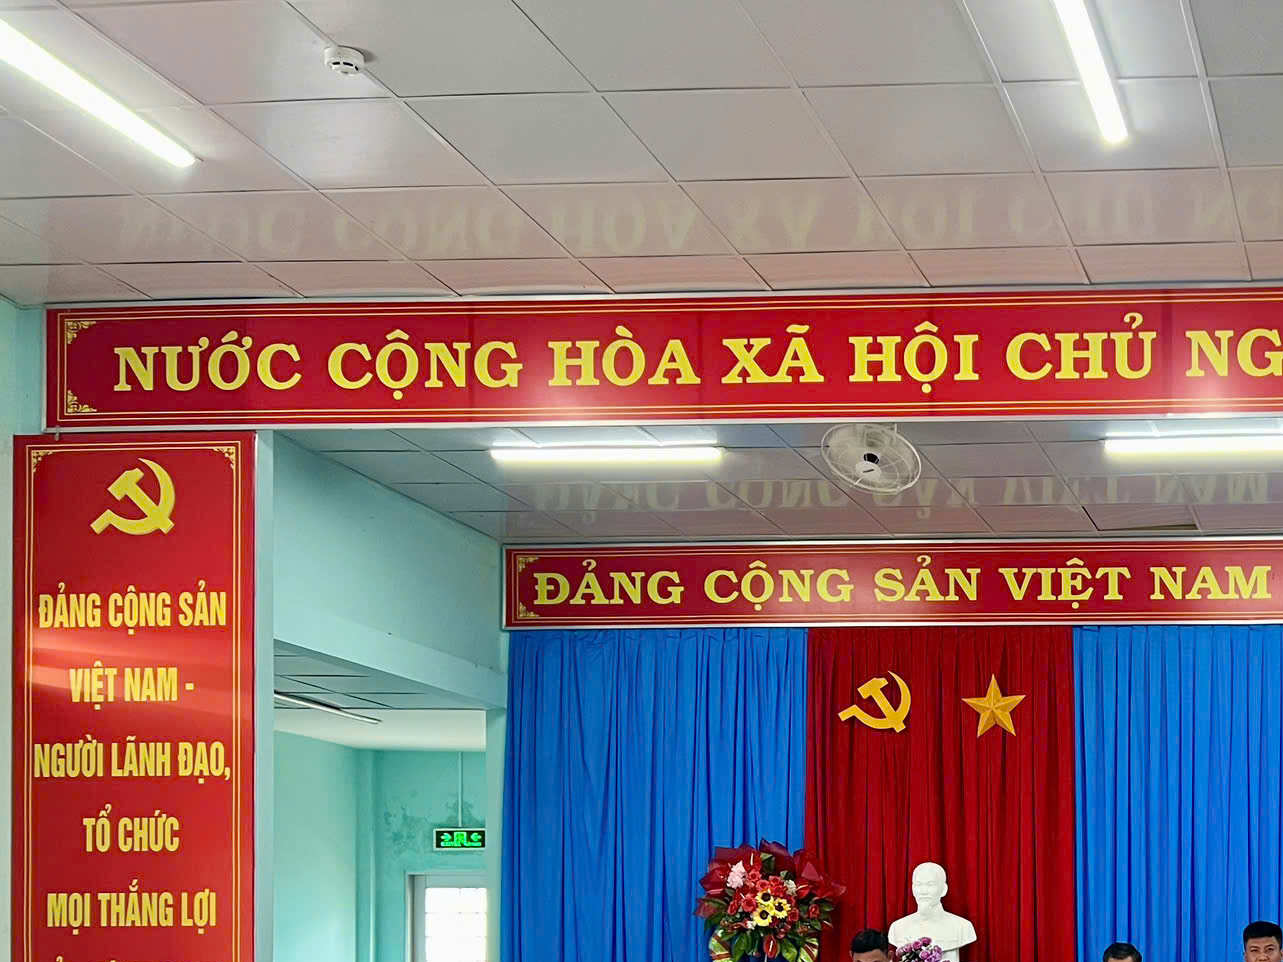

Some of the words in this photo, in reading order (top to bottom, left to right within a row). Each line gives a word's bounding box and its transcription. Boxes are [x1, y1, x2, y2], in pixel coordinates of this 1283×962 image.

[114, 331, 301, 391] NƯỚC
[328, 329, 523, 400] CỘNG
[548, 326, 701, 388] HÒA
[722, 325, 824, 383] XÃ
[849, 321, 979, 393] HỘI
[1006, 312, 1156, 380] CHỦ
[39, 582, 101, 628] ĐẢNG
[109, 585, 171, 635] CỘNG
[179, 580, 226, 626] SẢN
[534, 558, 684, 606] ĐẢNG
[704, 559, 856, 611] CỘNG
[873, 555, 981, 605] SẢN
[999, 558, 1131, 608] VIỆT
[1152, 565, 1272, 600] NAM
[70, 660, 117, 711] VIỆT
[124, 667, 179, 702] NAM
[34, 735, 103, 777] NGƯỜI
[112, 736, 171, 776] LÃNH
[178, 742, 230, 784] ĐẠO,
[83, 804, 111, 852] TỔ
[118, 810, 179, 852] CHỨC
[48, 893, 90, 935] MỌI
[98, 880, 173, 926] THẮNG
[182, 889, 216, 934] LỢI
